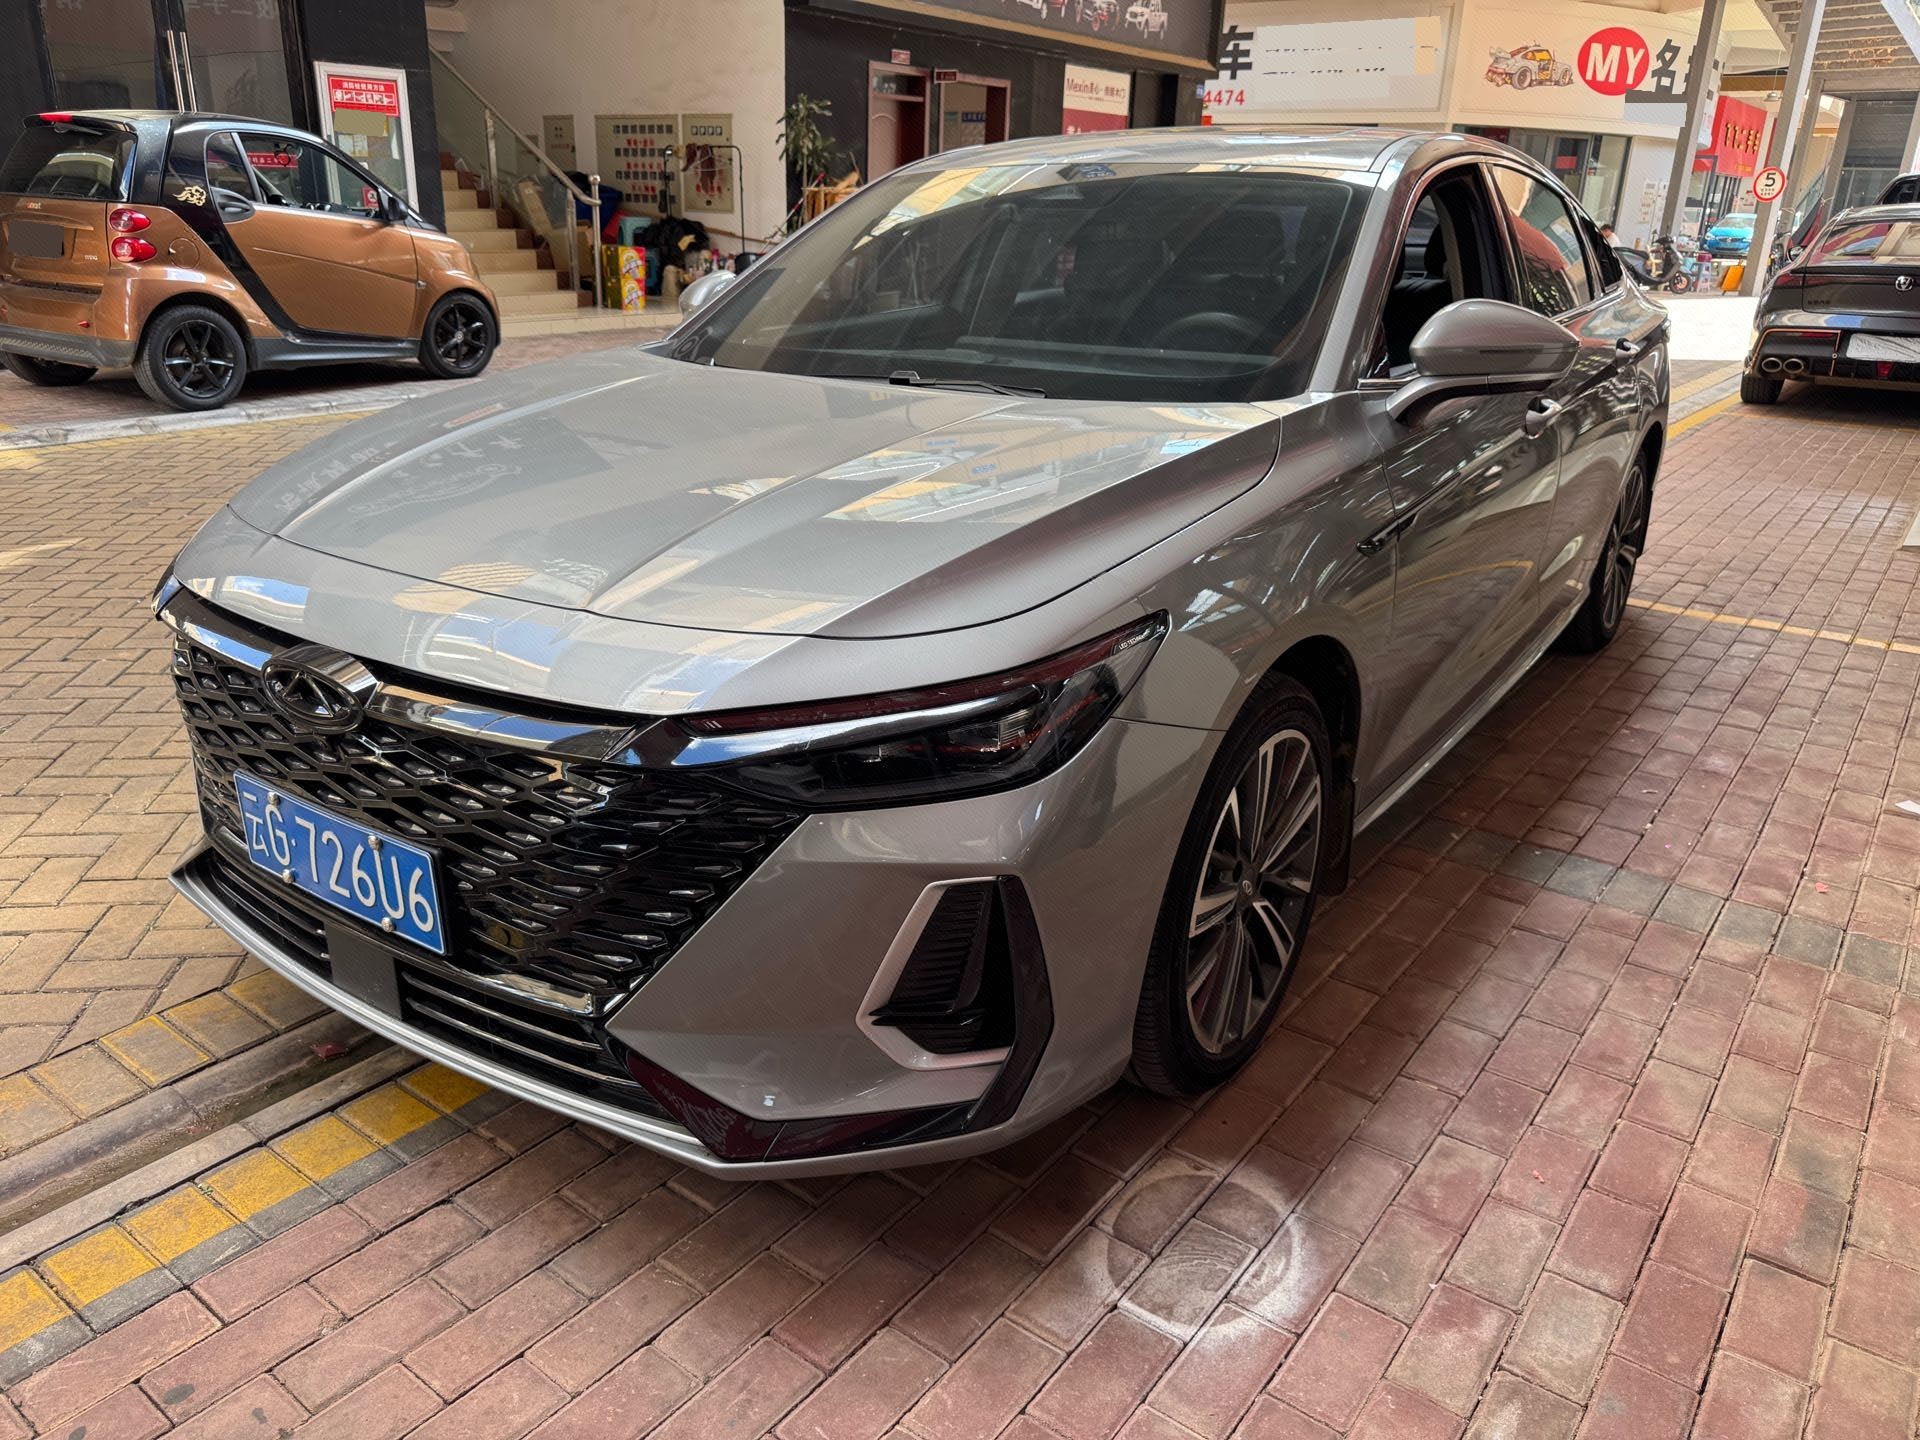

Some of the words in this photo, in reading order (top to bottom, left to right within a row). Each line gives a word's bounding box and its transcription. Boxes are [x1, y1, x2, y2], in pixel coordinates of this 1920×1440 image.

[1585, 42, 1646, 85] MY
[1202, 89, 1245, 106] 4474
[1764, 172, 1777, 188] 5
[243, 792, 434, 933] 云G·726U6
